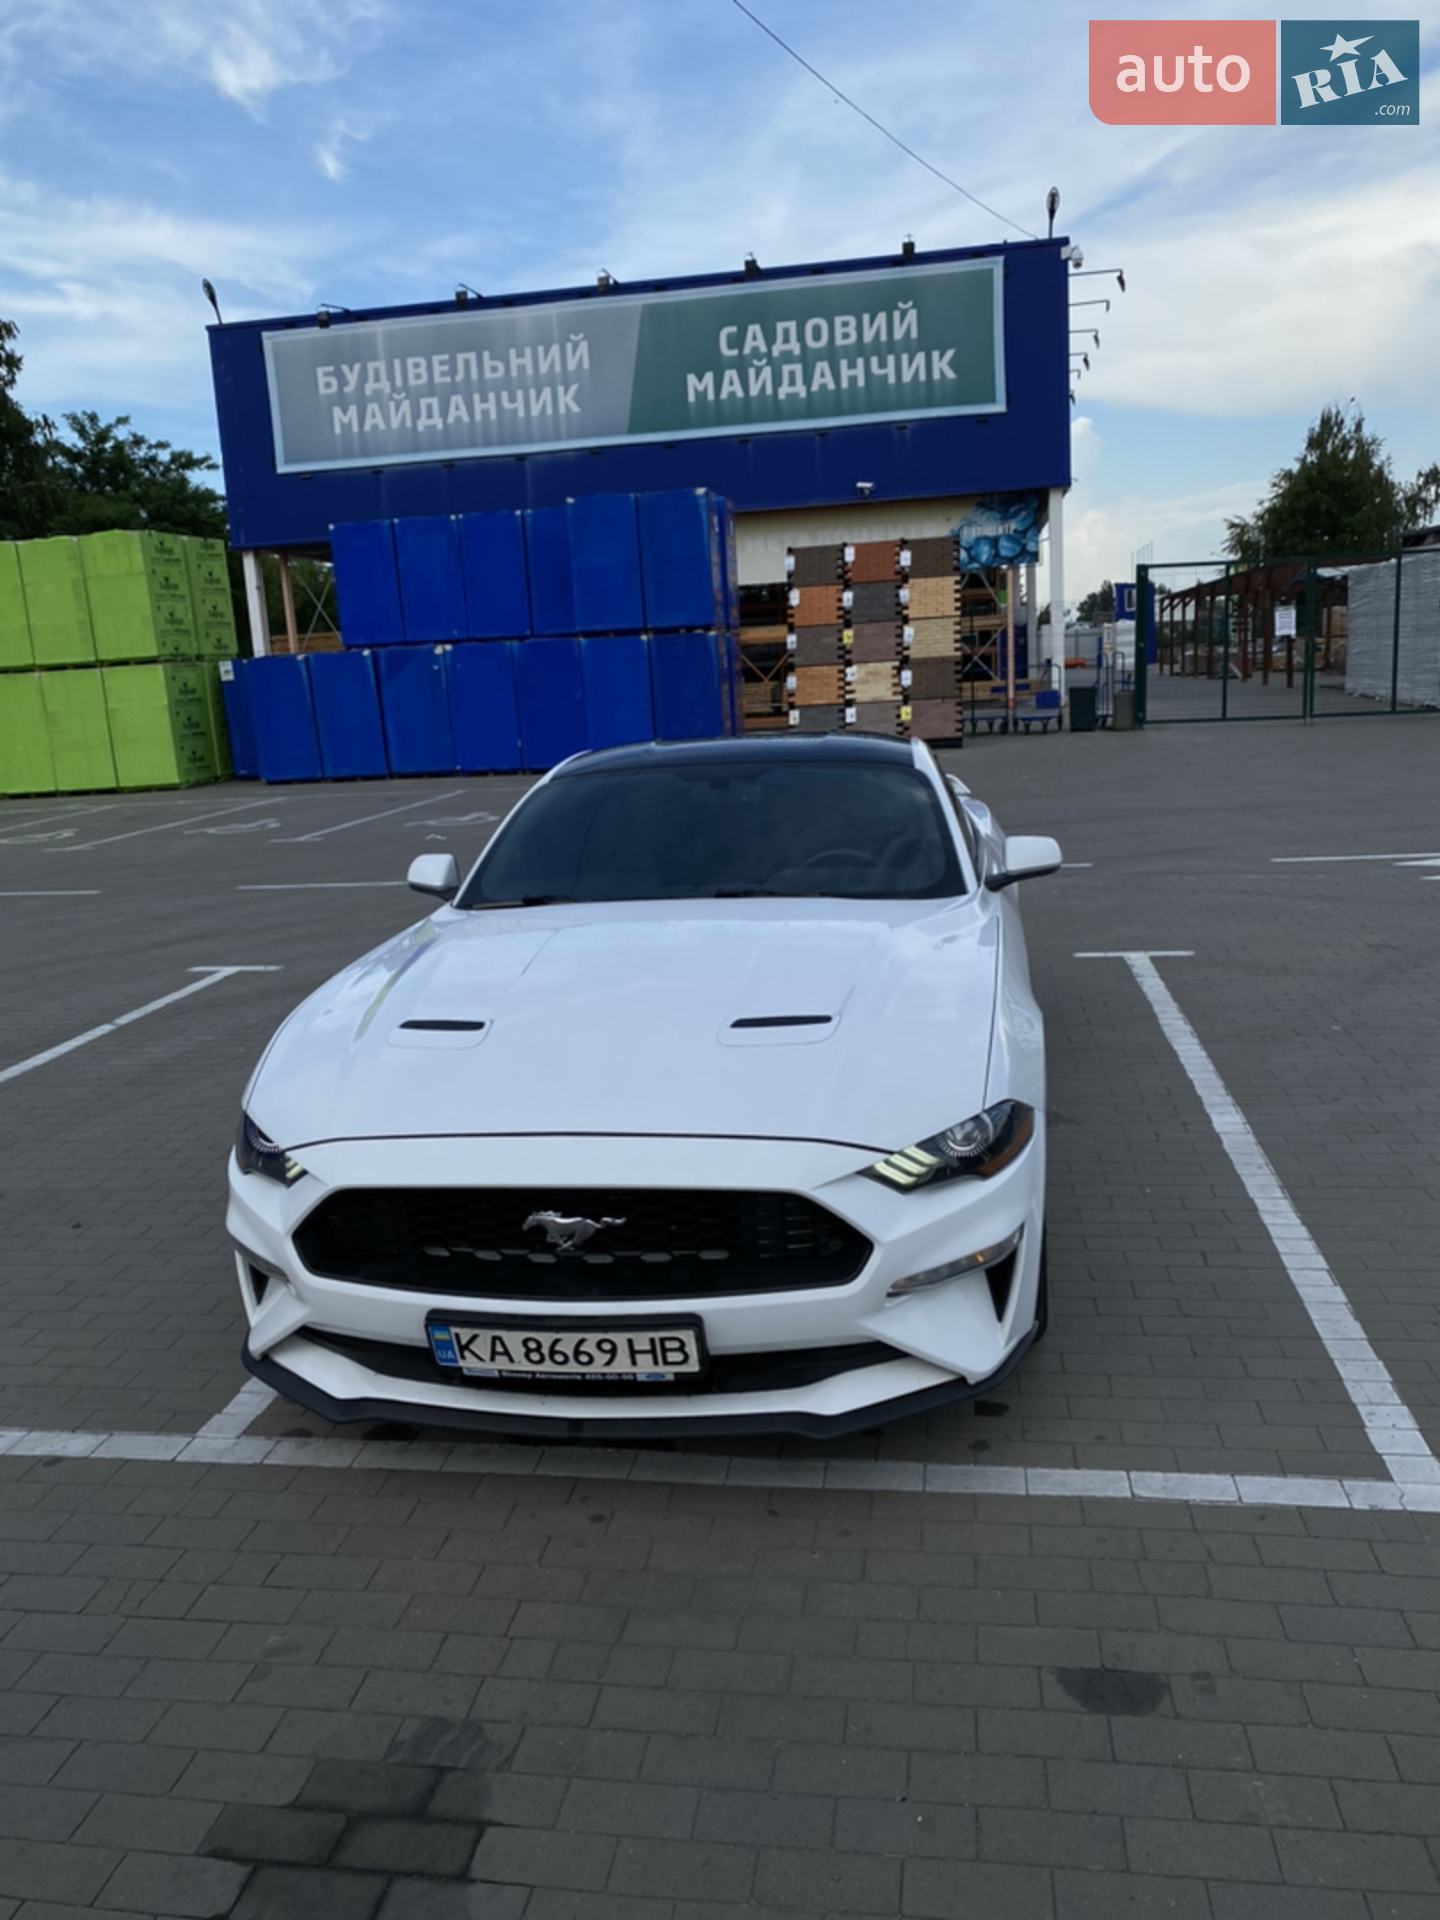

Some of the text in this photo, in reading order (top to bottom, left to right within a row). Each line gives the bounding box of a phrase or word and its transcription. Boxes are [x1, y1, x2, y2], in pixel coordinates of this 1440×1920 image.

[718, 300, 918, 357] САДОВИЙ
[315, 333, 590, 396] БУДІВЕЛЬНИЙ
[686, 348, 957, 402] МАЙДАНЧИК
[331, 384, 581, 434] МАЙДАНЧИК
[454, 1332, 690, 1366] KA 8669 HB
